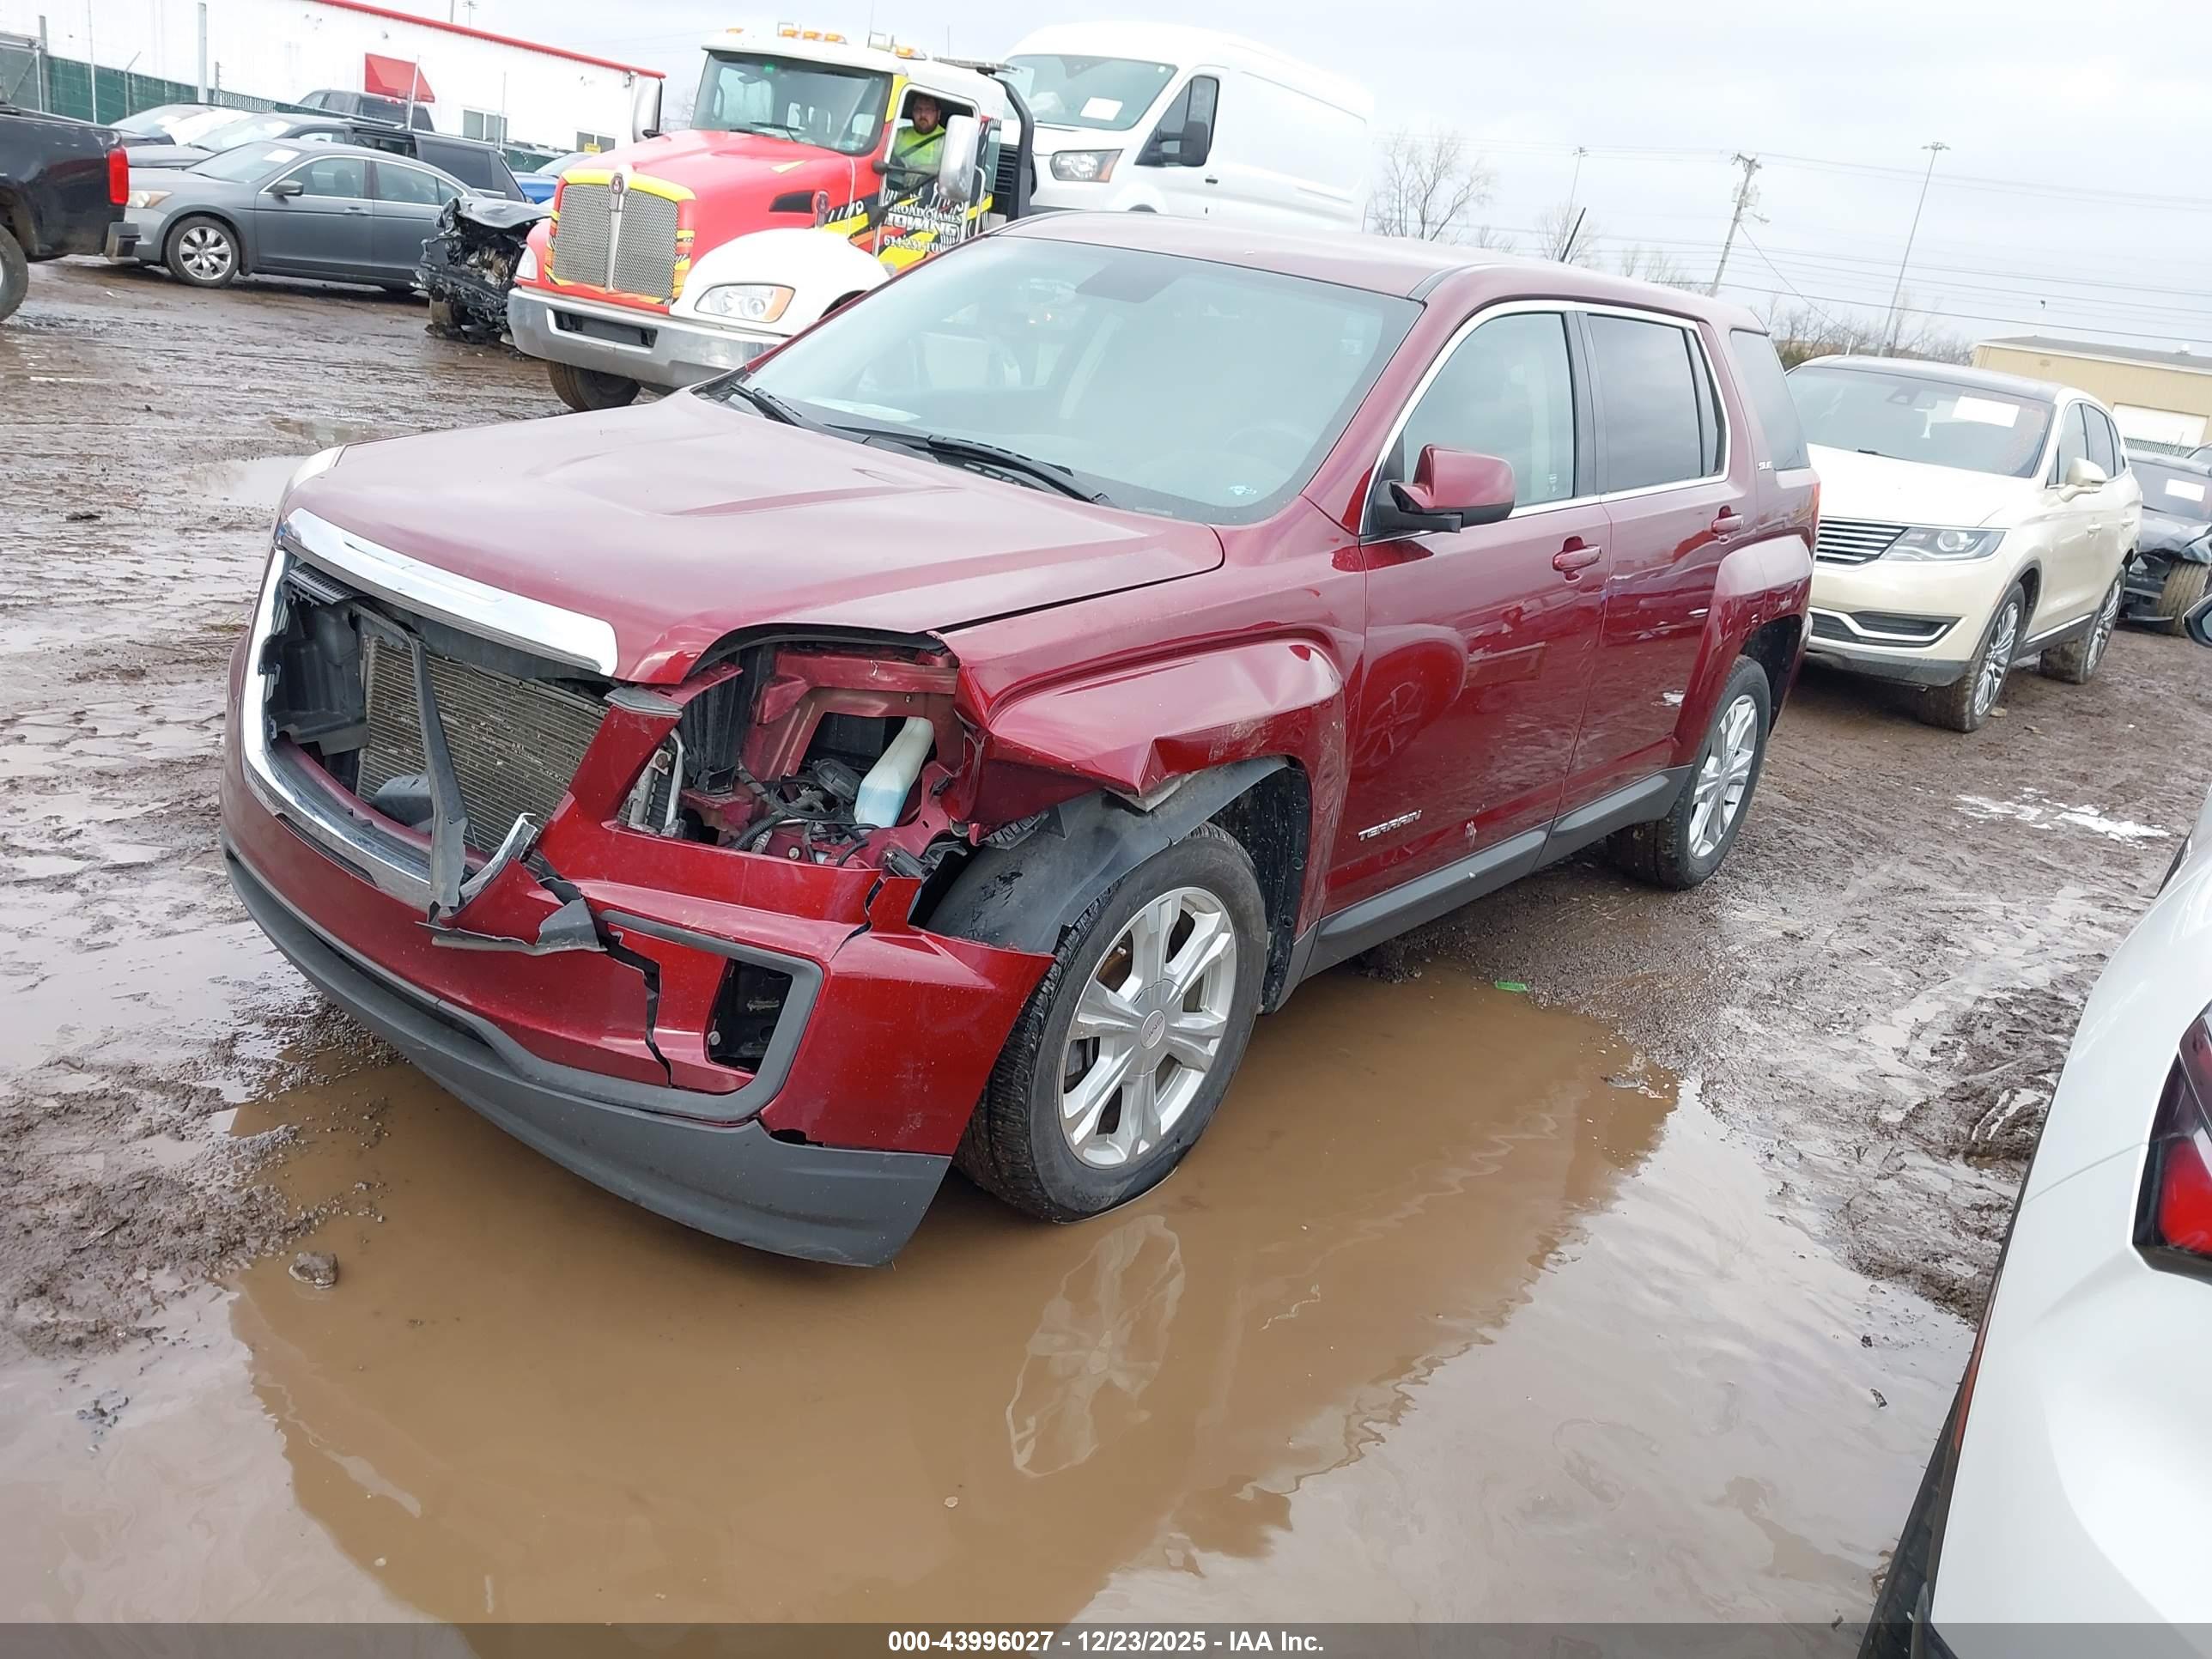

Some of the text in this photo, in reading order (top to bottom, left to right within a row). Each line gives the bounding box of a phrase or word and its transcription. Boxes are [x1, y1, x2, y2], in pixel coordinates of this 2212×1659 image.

[887, 212, 957, 236] TOWING
[888, 204, 923, 216] ROAD
[933, 209, 962, 223] JAMES
[1358, 810, 1422, 842] TERRAIN
